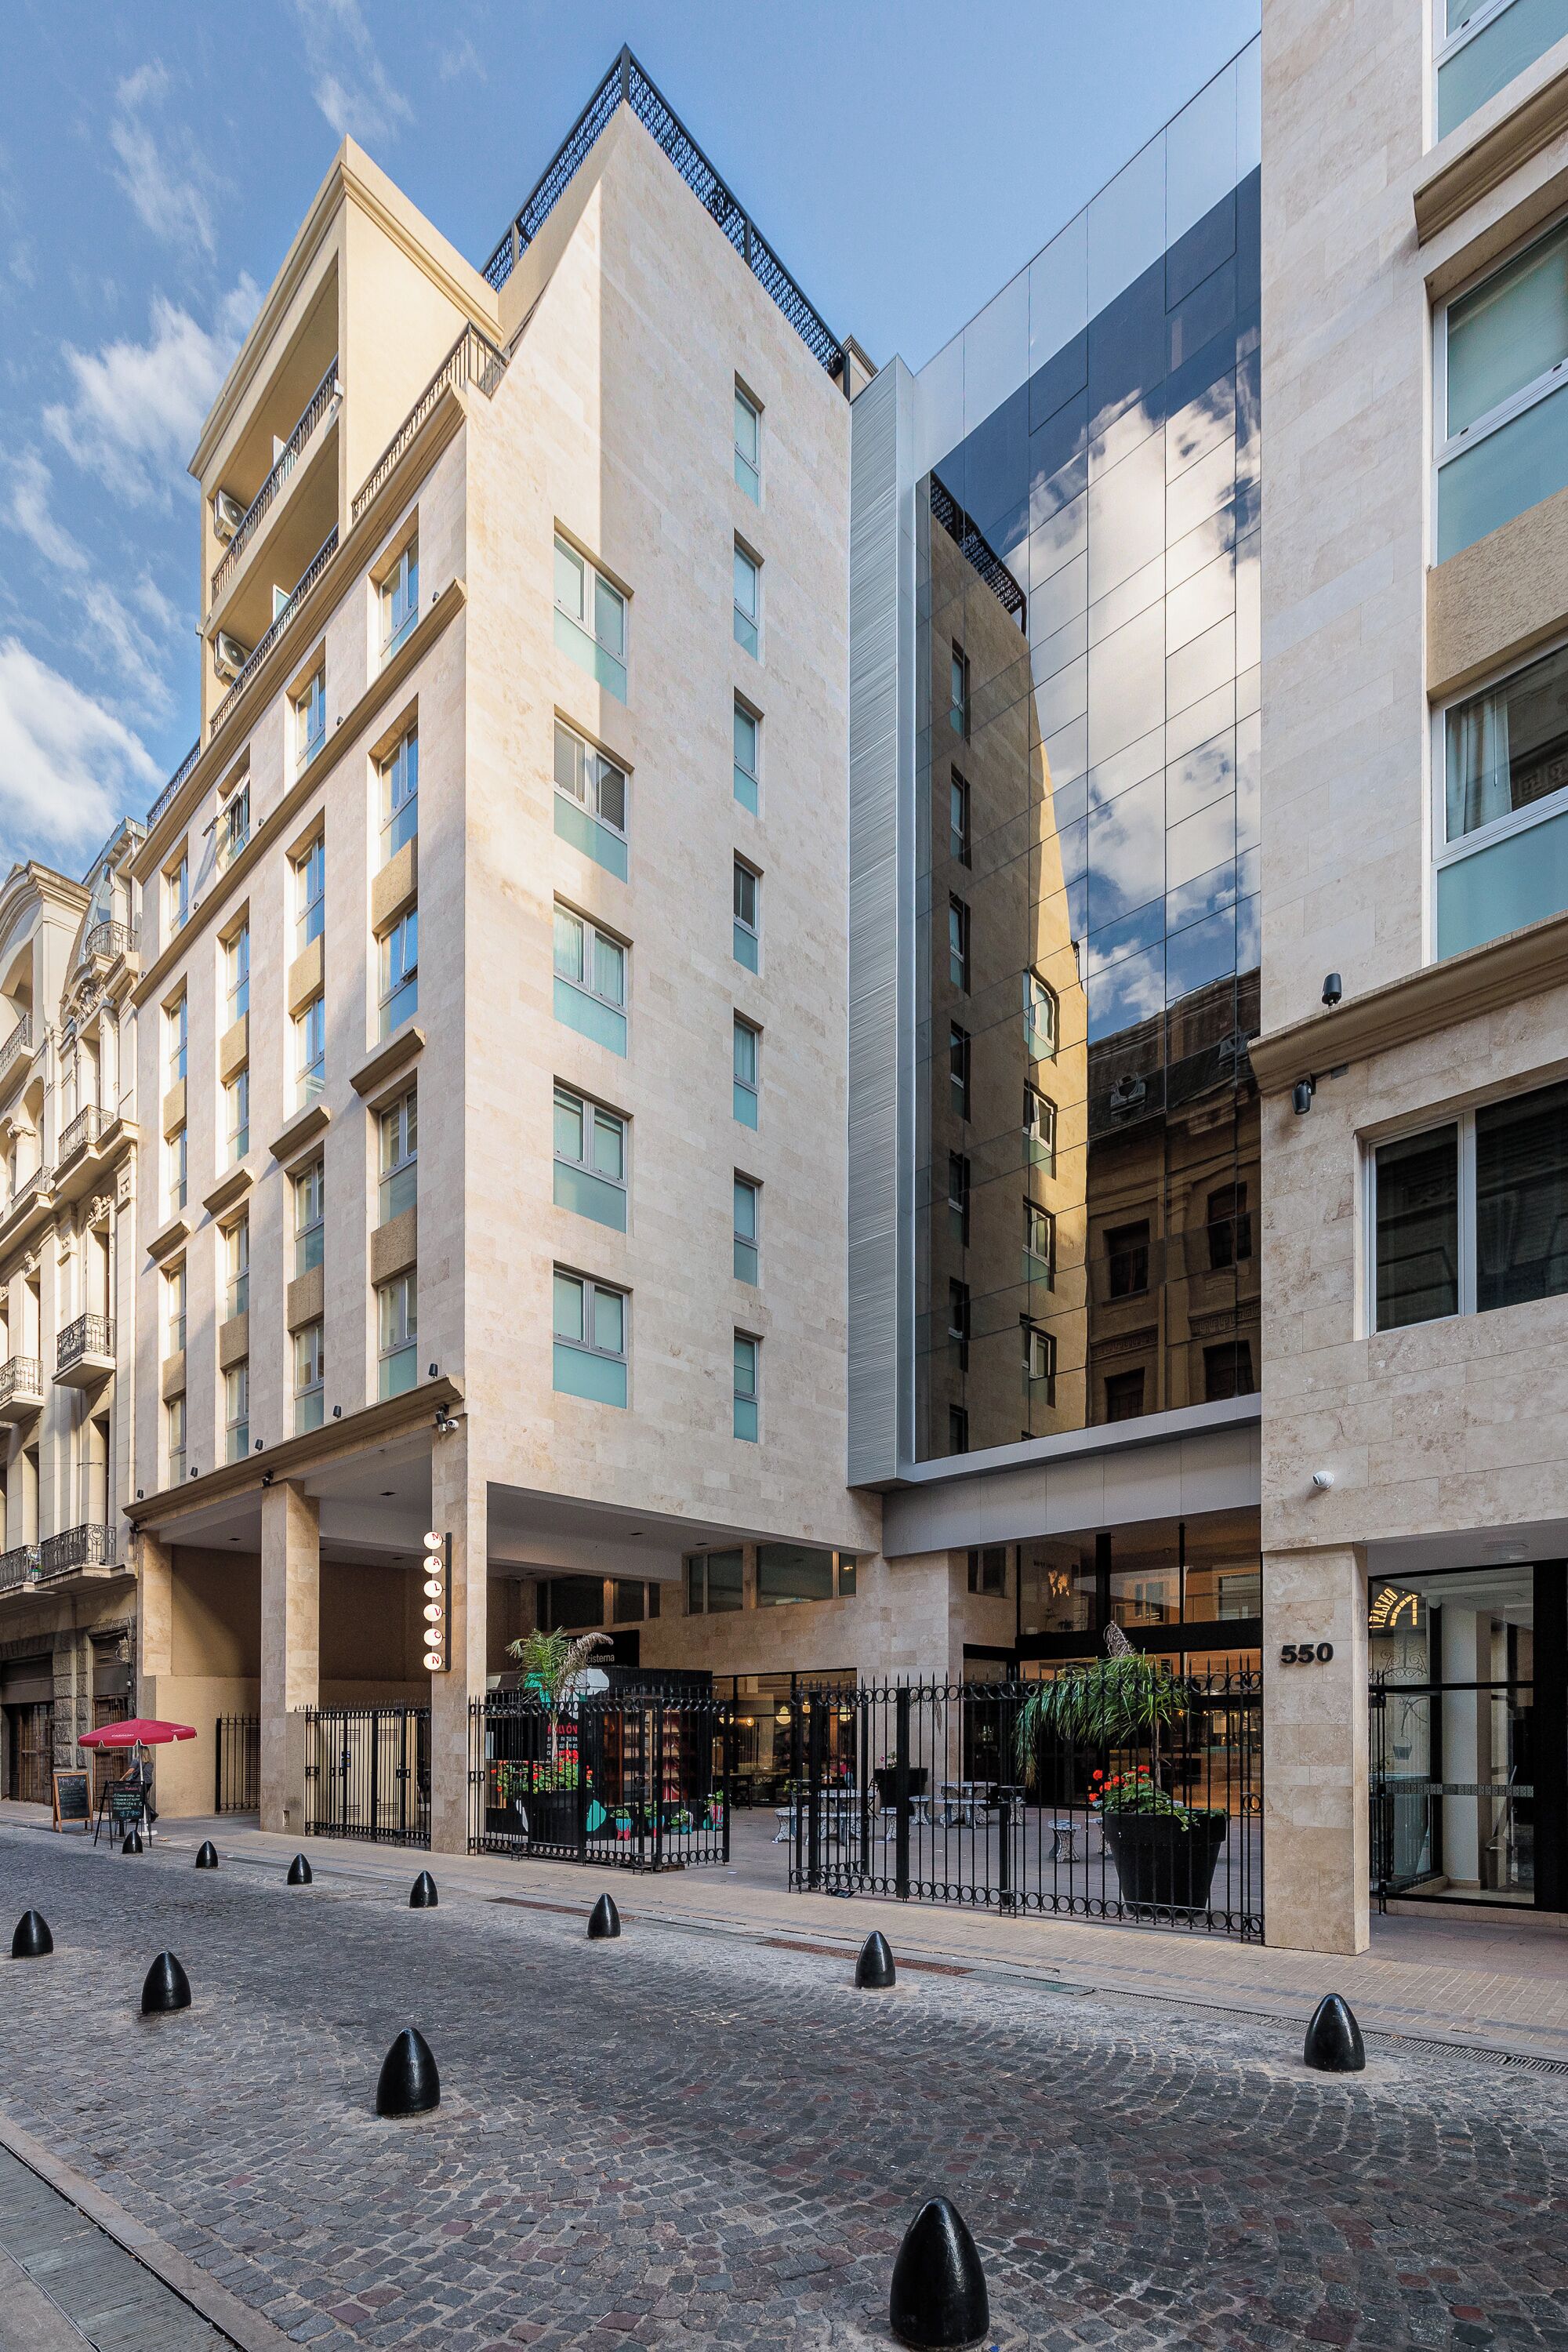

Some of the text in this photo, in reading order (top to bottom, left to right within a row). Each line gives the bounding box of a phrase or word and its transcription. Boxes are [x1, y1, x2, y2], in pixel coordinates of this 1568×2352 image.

[1369, 1588, 1399, 1624] PASEO
[586, 1654, 615, 1663] cisterna
[1280, 1642, 1334, 1664] 550
